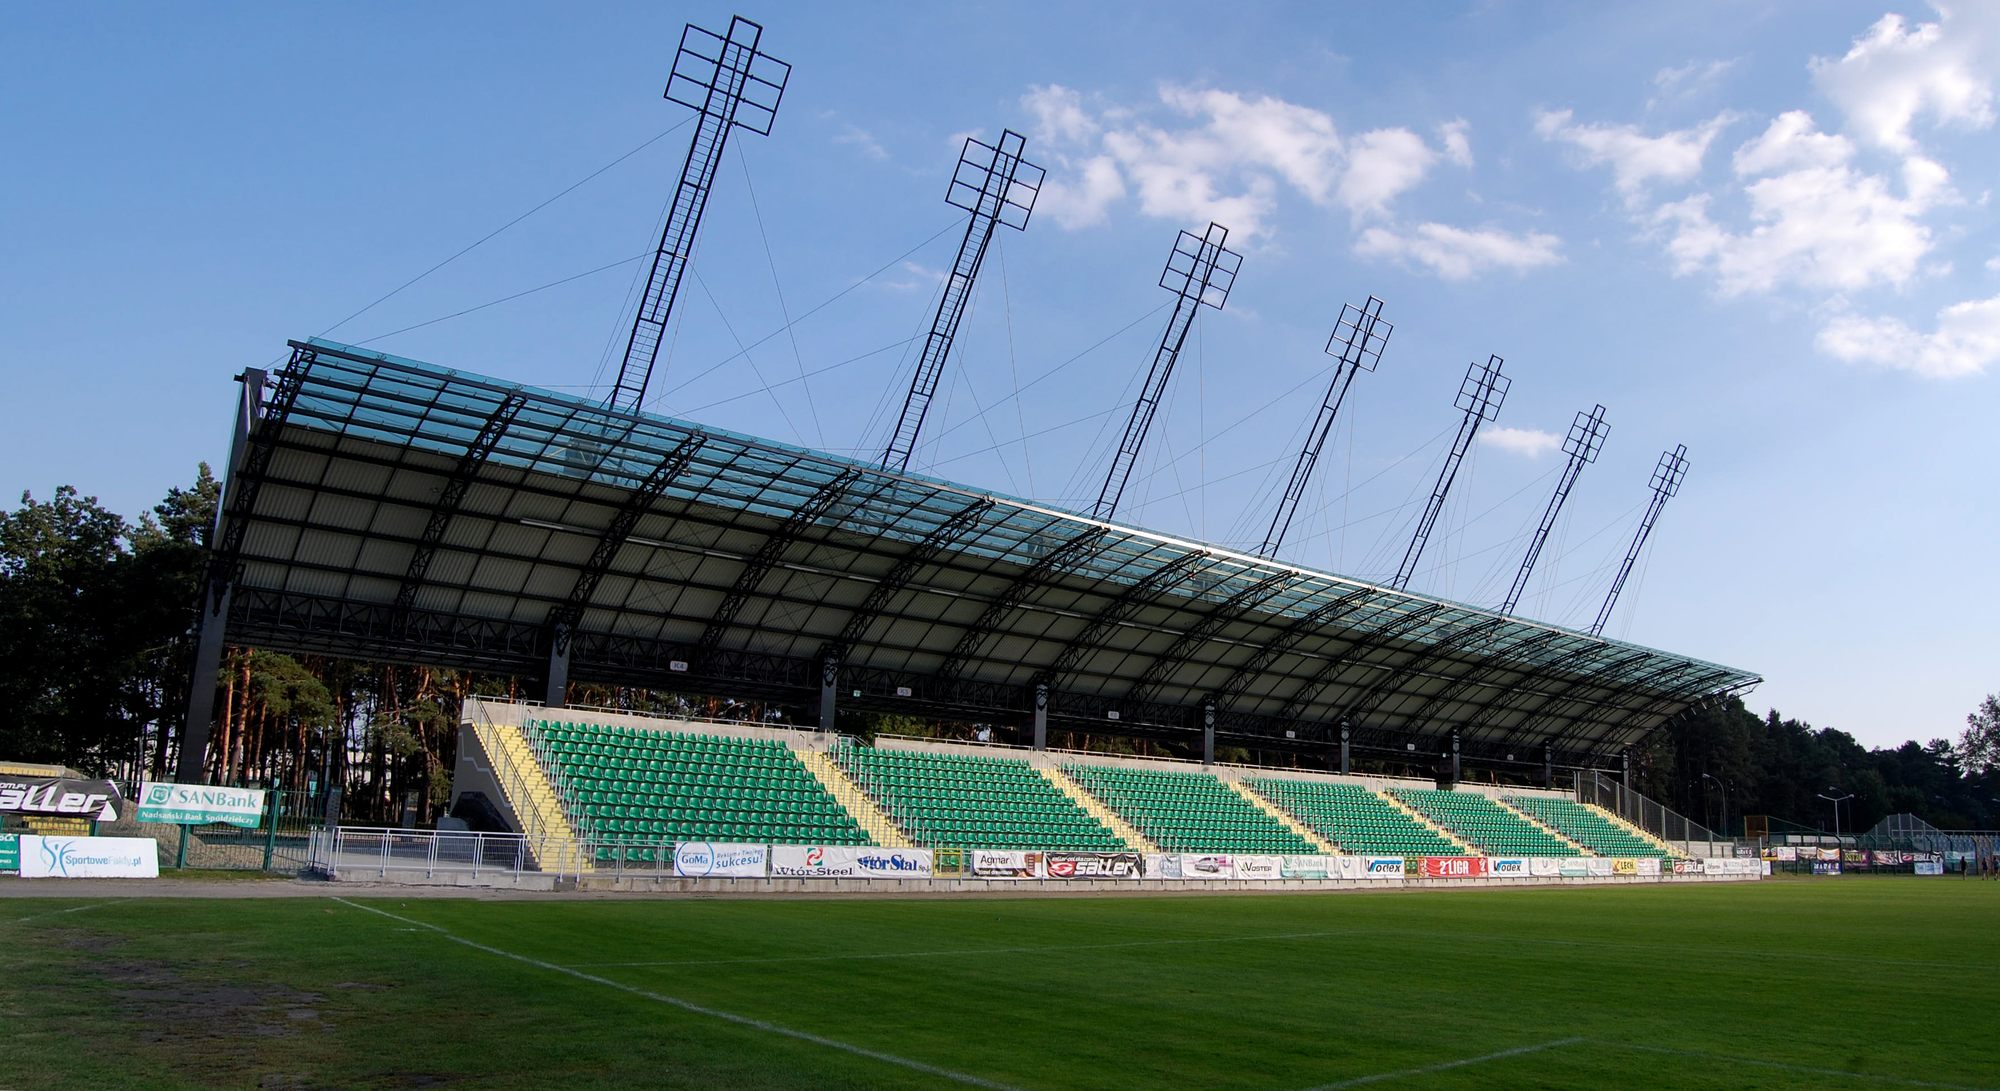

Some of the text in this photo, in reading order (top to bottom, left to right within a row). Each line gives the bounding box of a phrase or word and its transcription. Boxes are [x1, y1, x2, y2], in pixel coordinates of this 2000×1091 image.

[179, 789, 257, 808] SANBank
[141, 811, 183, 820] Nadsański
[204, 814, 254, 825] Spółdzielczy
[681, 855, 709, 864] GoMa
[716, 853, 763, 868] sukcesu!
[980, 855, 1010, 866] Agmar
[775, 866, 853, 876] Wtór-Steel
[1620, 862, 1634, 870] LECH
